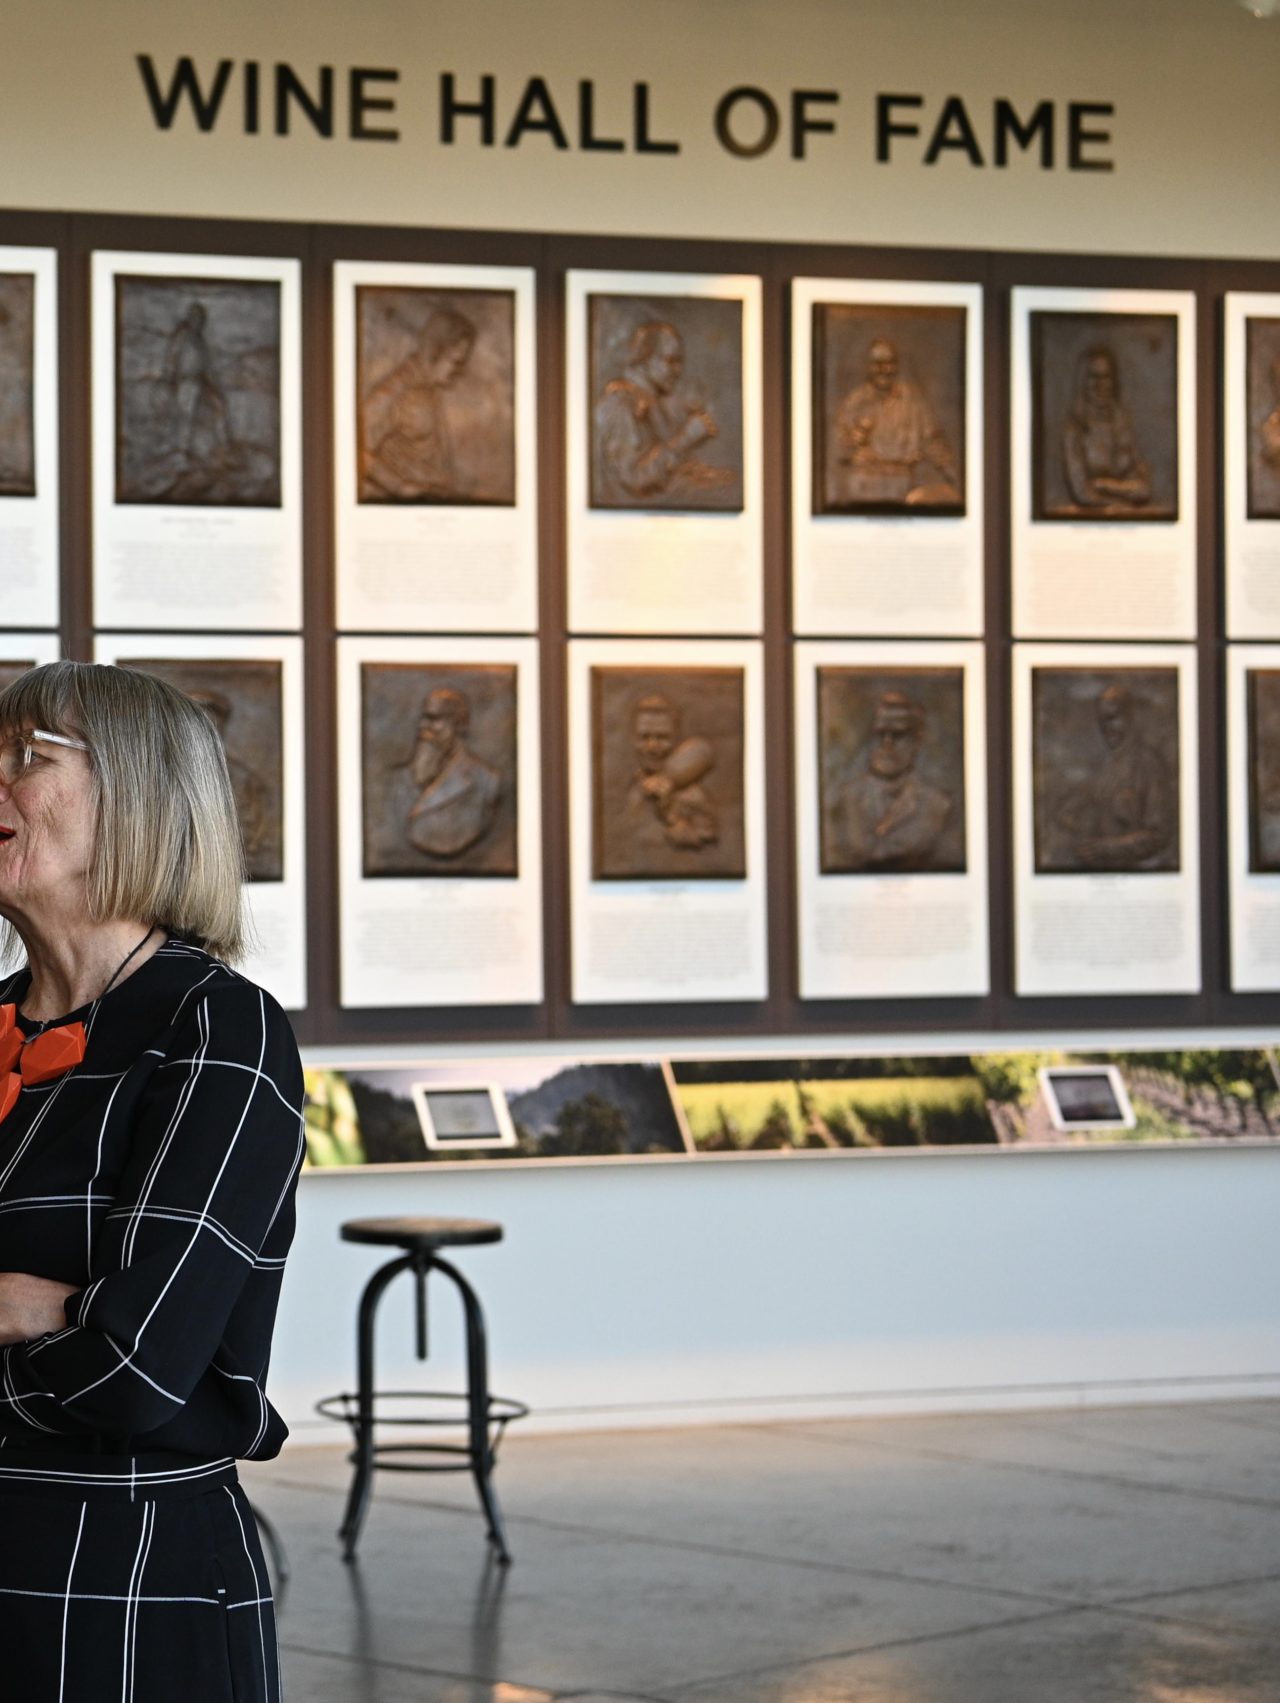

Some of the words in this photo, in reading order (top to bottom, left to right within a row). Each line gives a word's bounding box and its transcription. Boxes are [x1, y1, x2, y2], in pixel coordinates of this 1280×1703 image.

[136, 54, 400, 141] WINE
[440, 72, 681, 155] HALL
[713, 85, 840, 160] OF
[875, 93, 1116, 172] FAME
